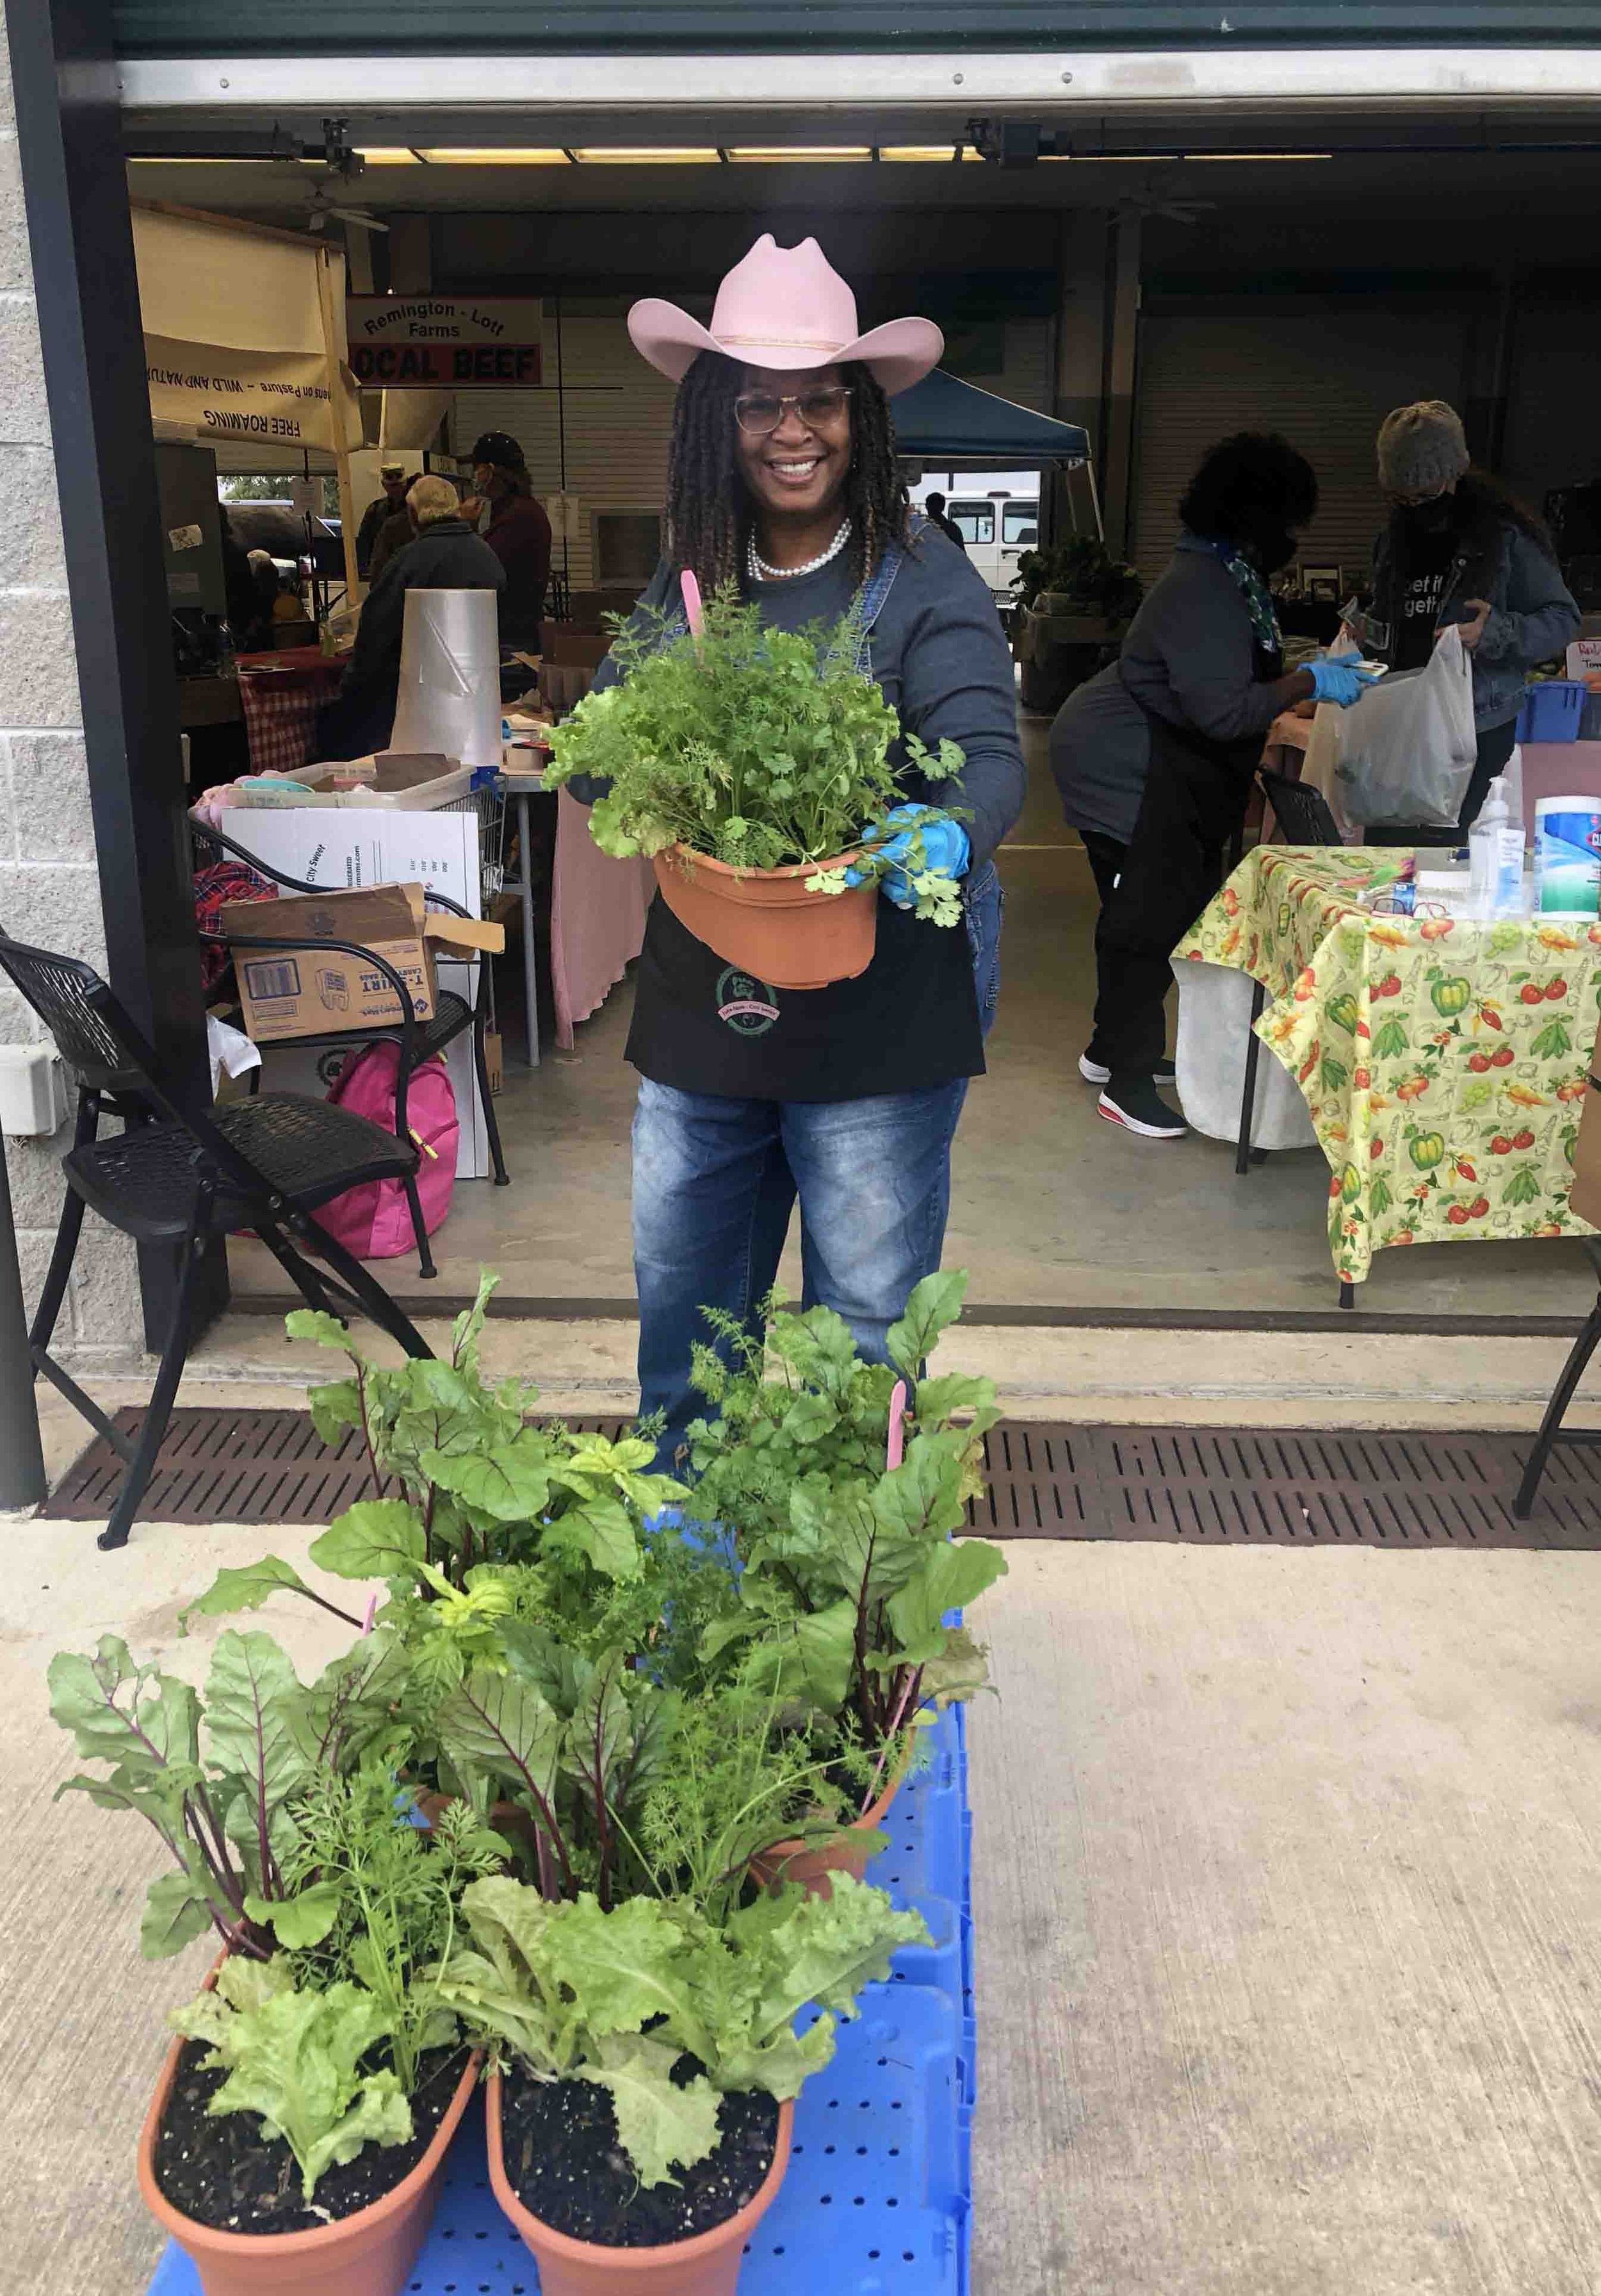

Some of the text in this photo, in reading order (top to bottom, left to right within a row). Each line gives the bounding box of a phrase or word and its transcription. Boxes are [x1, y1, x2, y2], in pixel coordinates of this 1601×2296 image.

[363, 300, 455, 335] Remington
[471, 309, 505, 337] Lott
[408, 322, 460, 338] Farms
[354, 347, 534, 379] OCAL BEEF
[148, 368, 183, 387] NATU
[185, 375, 209, 390] AND
[213, 378, 243, 393] WILD
[261, 382, 301, 398] Pasture
[303, 386, 313, 397] on
[204, 410, 300, 437] FREE ROAMING
[306, 844, 326, 883] City Sweet
